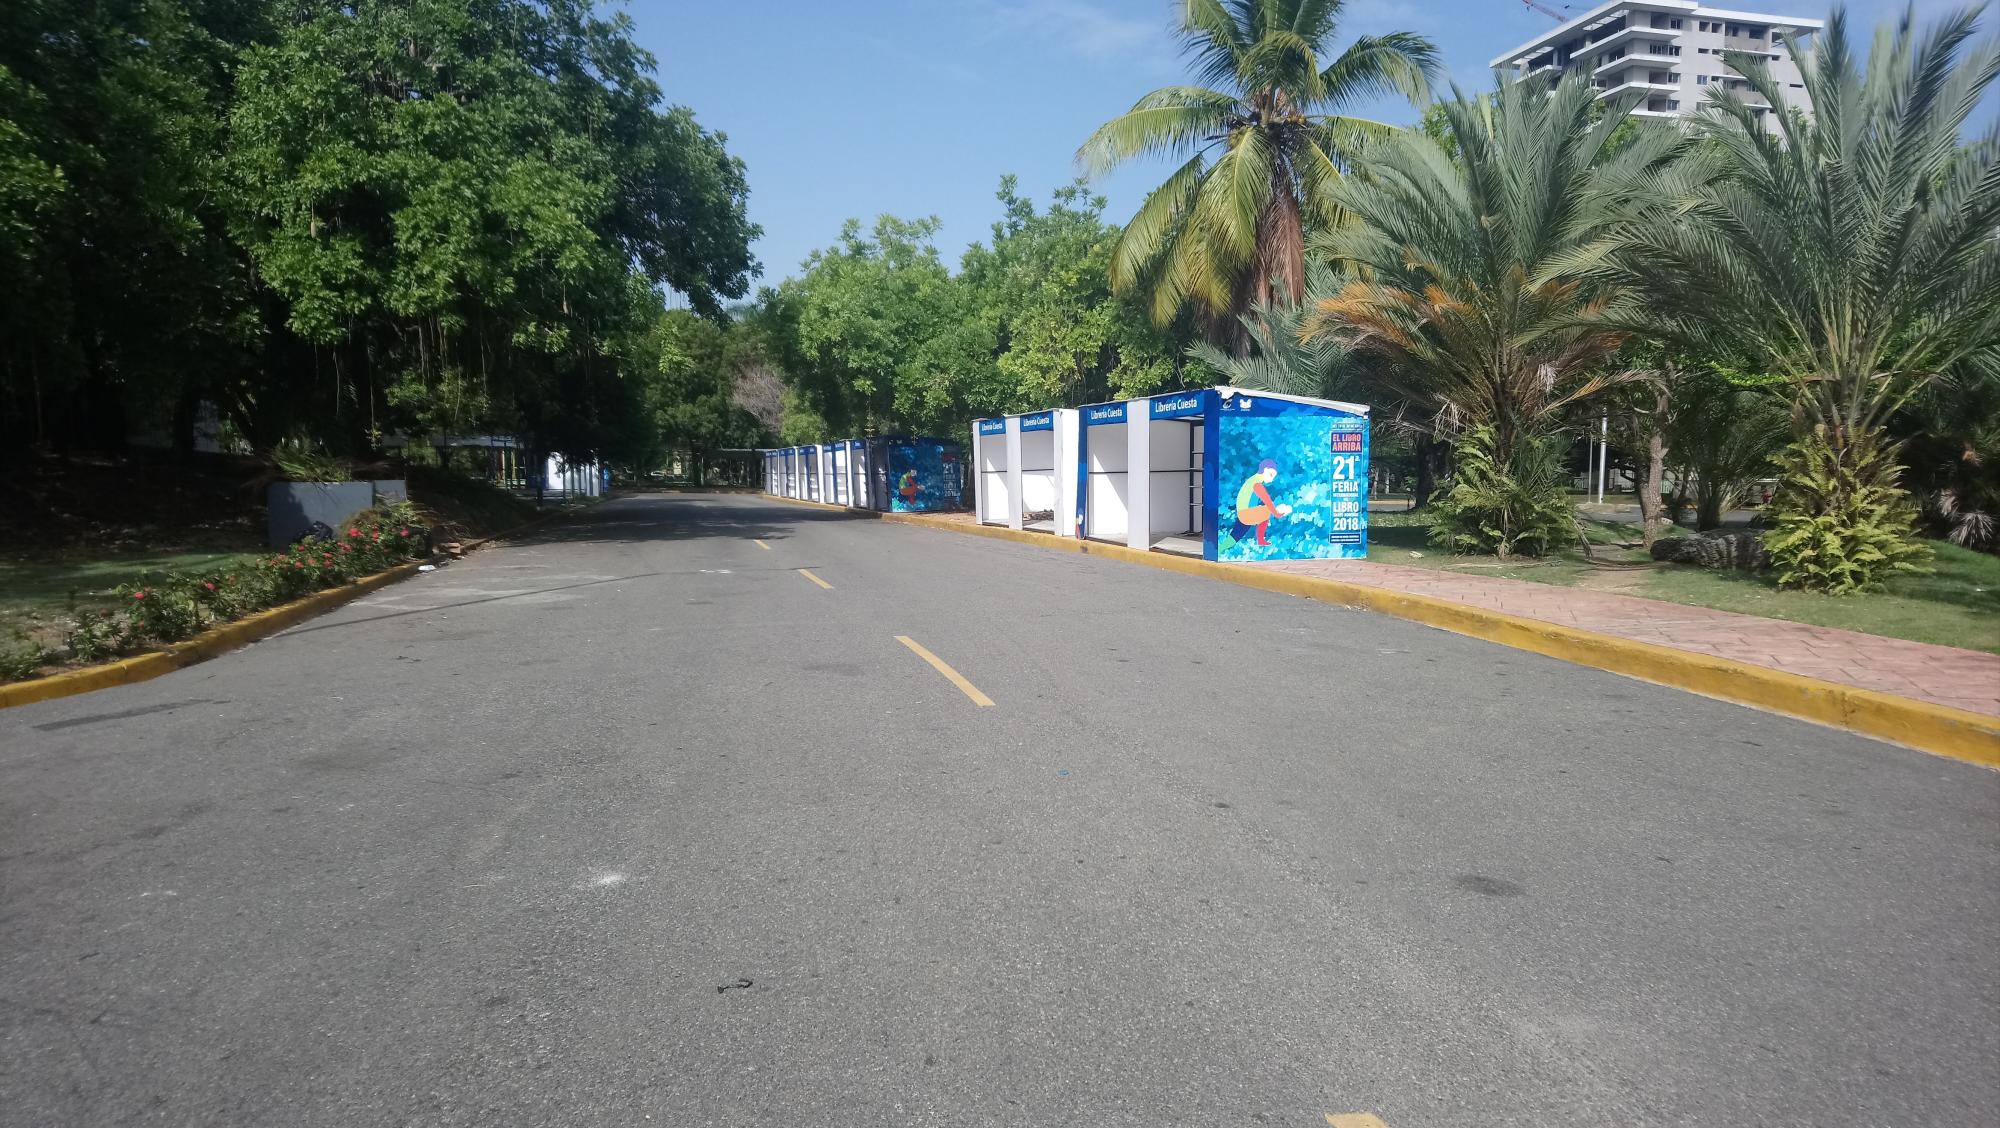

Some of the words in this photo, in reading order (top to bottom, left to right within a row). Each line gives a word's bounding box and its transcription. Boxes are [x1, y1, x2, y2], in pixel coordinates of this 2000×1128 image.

[1155, 400, 1176, 413] Librería
[1177, 398, 1197, 410] Cuesta
[1107, 407, 1123, 418] Cuesta
[1332, 433, 1341, 442] EL
[1342, 433, 1361, 442] LIBRO
[1332, 442, 1361, 452] ARRIBA
[1332, 481, 1359, 493] FERIA
[1332, 501, 1359, 513] LIBRO
[1333, 517, 1359, 531] 2018
